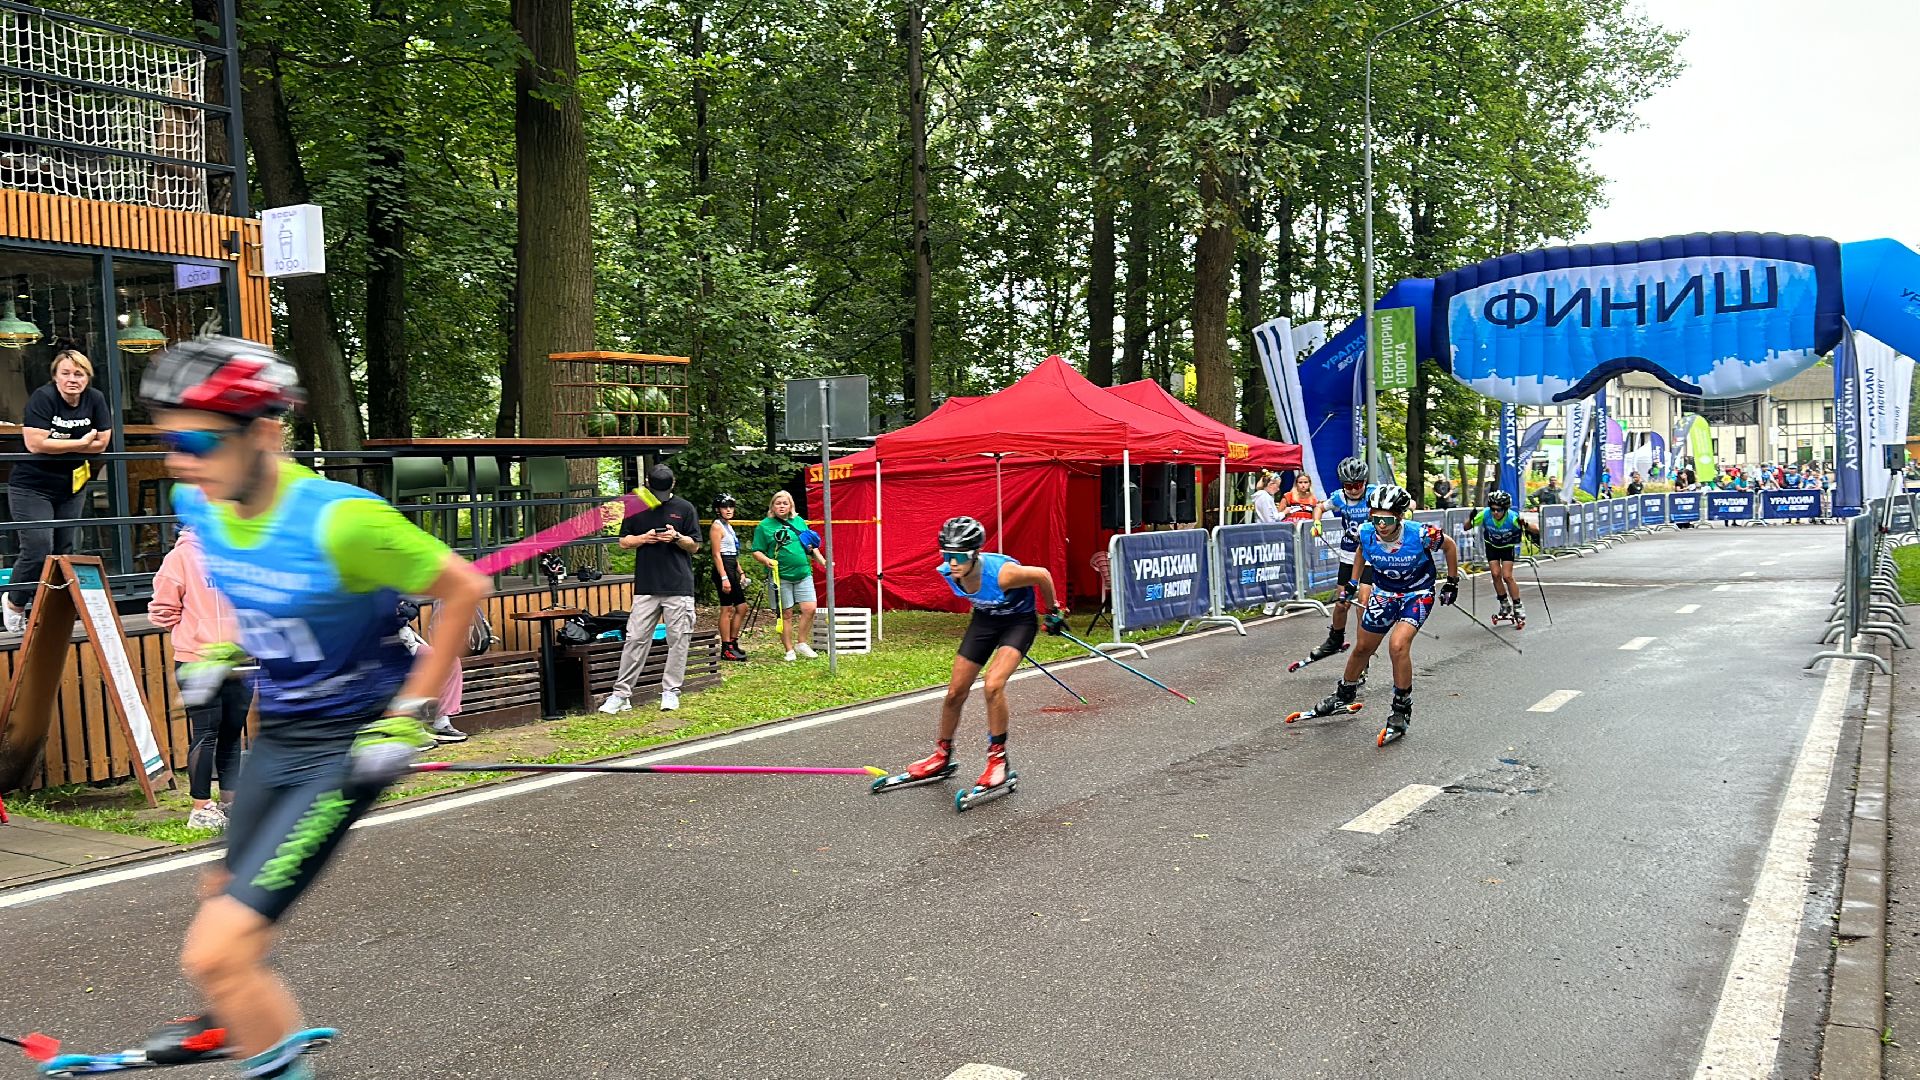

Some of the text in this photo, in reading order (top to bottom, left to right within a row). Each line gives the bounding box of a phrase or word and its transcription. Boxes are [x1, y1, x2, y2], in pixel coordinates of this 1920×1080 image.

[286, 259, 299, 272] go
[1484, 266, 1778, 329] ФИНИШ
[1381, 315, 1394, 386] ТЕРРИТОРИЯ
[1395, 342, 1407, 385] СПОРТА
[1878, 378, 1886, 416] FACTORY
[1133, 553, 1198, 580] УРАЛХИМ
[1231, 543, 1286, 567] УРАЛХИМ
[1164, 579, 1192, 598] FACTORY
